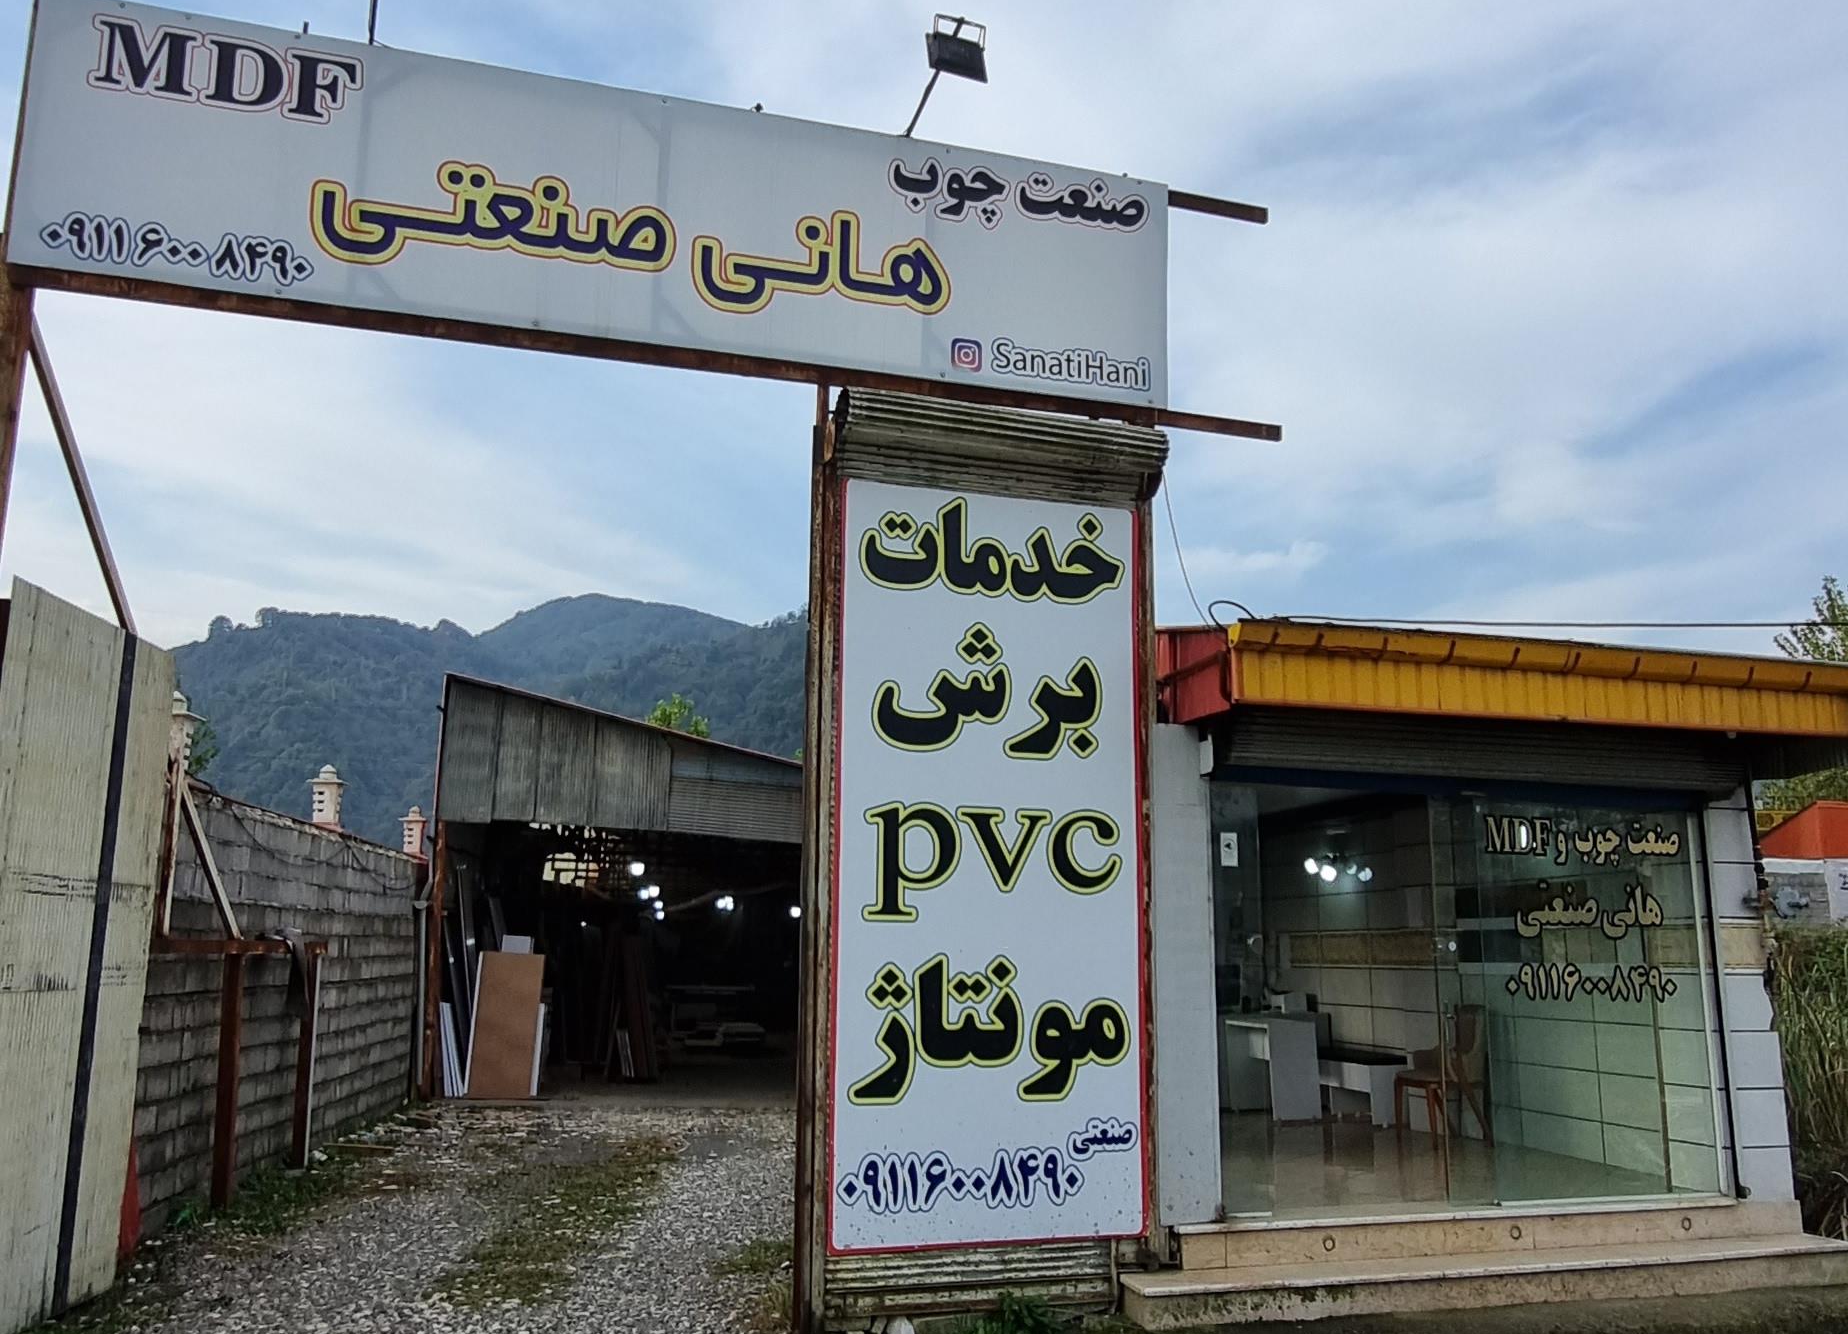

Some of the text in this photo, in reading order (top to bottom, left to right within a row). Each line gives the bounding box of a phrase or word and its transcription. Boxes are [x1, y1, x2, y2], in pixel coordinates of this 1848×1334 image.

[92, 16, 361, 122] MDF
[314, 163, 947, 311] هانی صنعتی
[891, 159, 1147, 230] صنعت چوب
[992, 339, 1149, 389] SanatiHani
[862, 500, 1122, 602] خدمات
[874, 625, 1101, 757] برش
[863, 803, 1120, 920] pvc
[1485, 816, 1680, 866] صنعت چوب و MDF
[1515, 880, 1664, 939] هانی صنعتی
[851, 955, 1129, 1103] مونتاژ
[1069, 1119, 1136, 1158] صنعتی
